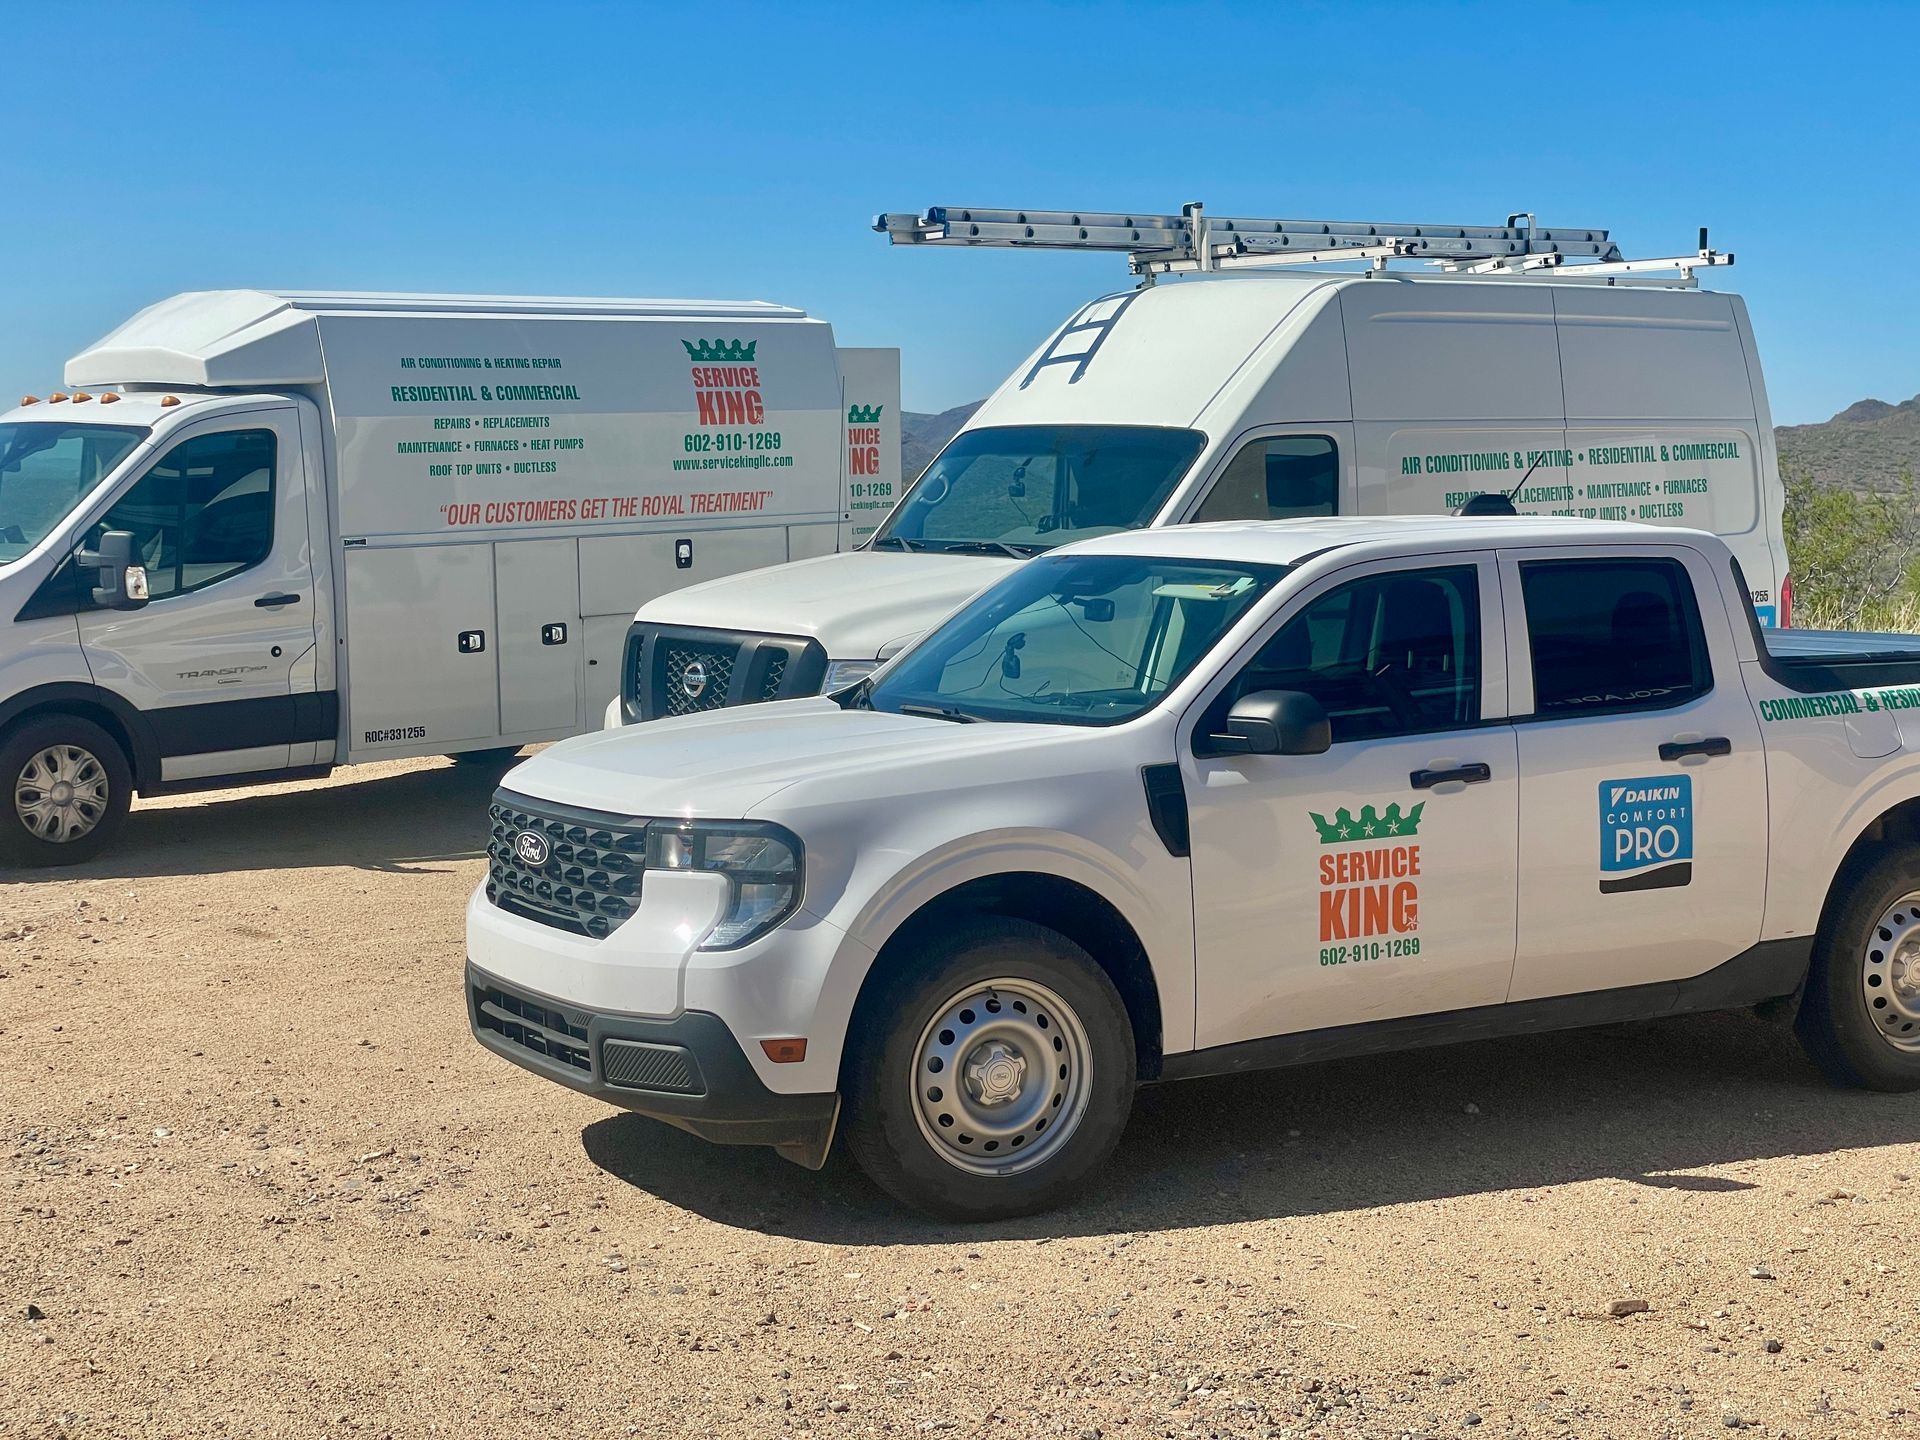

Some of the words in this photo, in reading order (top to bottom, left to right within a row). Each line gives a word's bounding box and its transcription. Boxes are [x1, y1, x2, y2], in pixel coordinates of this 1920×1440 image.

[401, 357, 416, 369] AIR
[418, 357, 481, 369] CONDITIONING
[484, 358, 492, 369] &
[494, 358, 530, 369] HEATING
[532, 358, 562, 369] REPAIR
[692, 367, 760, 388] SERVICE
[391, 386, 477, 402] RESIDENTIAL
[481, 385, 493, 401] &
[496, 385, 581, 401] COMMERCIAL
[696, 390, 764, 425] KING
[434, 418, 471, 430] REPAIRS
[483, 416, 550, 429] REPLACEMENTS
[397, 441, 462, 454] MAINTENANCE
[474, 440, 519, 452] FURNACES
[530, 439, 552, 451] HEAT
[554, 438, 584, 450] PUMPS
[684, 432, 781, 452] 602-910-1269
[673, 455, 793, 471] www.servicekingllc.com
[1402, 456, 1421, 474] AIR
[1426, 452, 1509, 473] CONDITIONING
[1514, 451, 1523, 469] &
[1527, 450, 1573, 468] HEATING
[1589, 446, 1657, 465] RESIDENTIAL
[1661, 445, 1669, 462] &
[1673, 442, 1740, 461] COMMERCIAL
[429, 464, 453, 477] ROOF
[455, 464, 473, 476] TOP
[475, 463, 502, 475] UNITS
[514, 461, 557, 474] DUCTLESS
[850, 482, 892, 497] 10-1269
[1445, 491, 1486, 508] REPA
[1587, 481, 1651, 499] MAINTENANCE
[1663, 478, 1707, 494] FURNACES
[485, 499, 577, 523] CUSTOMERS
[580, 499, 608, 519] GET
[612, 497, 638, 517] THE
[641, 495, 685, 516] ROYAL
[1578, 508, 1596, 519] TOP
[1600, 506, 1627, 521] UNITS
[1639, 502, 1684, 518] DUCTLESS
[176, 666, 248, 679] TRANSIT
[1759, 694, 1862, 722] COMMERCIAL
[1862, 692, 1880, 712] &
[1877, 688, 1920, 710] RESID
[365, 726, 426, 743] ROC#331255
[1626, 787, 1679, 803] DAIKIN
[1607, 808, 1685, 824] COMFORT
[520, 835, 542, 861] Ford
[1615, 825, 1680, 863] PRO
[1320, 845, 1421, 886] SERVICE
[1320, 881, 1418, 942] KING
[1320, 937, 1420, 967] 602-910-1269
